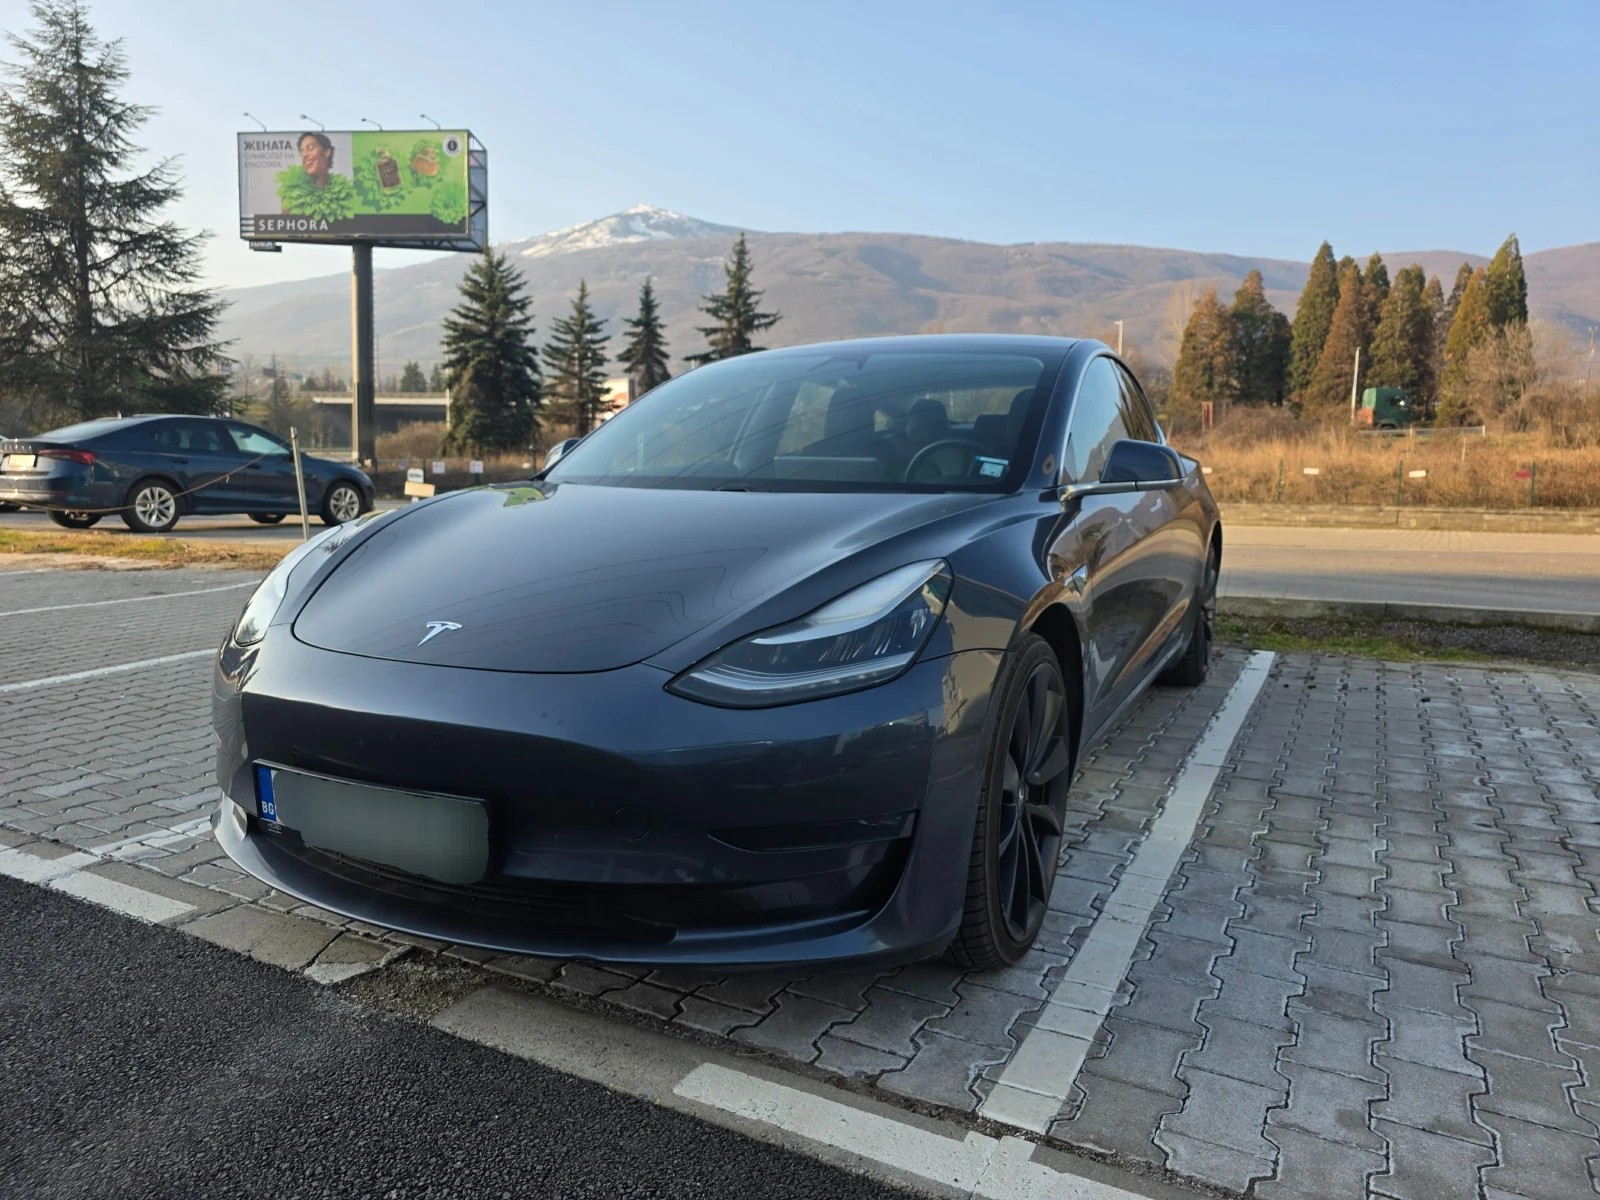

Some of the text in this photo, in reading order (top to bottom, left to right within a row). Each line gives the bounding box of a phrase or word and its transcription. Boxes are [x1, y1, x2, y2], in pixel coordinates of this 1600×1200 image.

[244, 140, 292, 151] ЖЕНАТА
[258, 219, 329, 231] SEPHORA
[261, 800, 275, 815] BG
